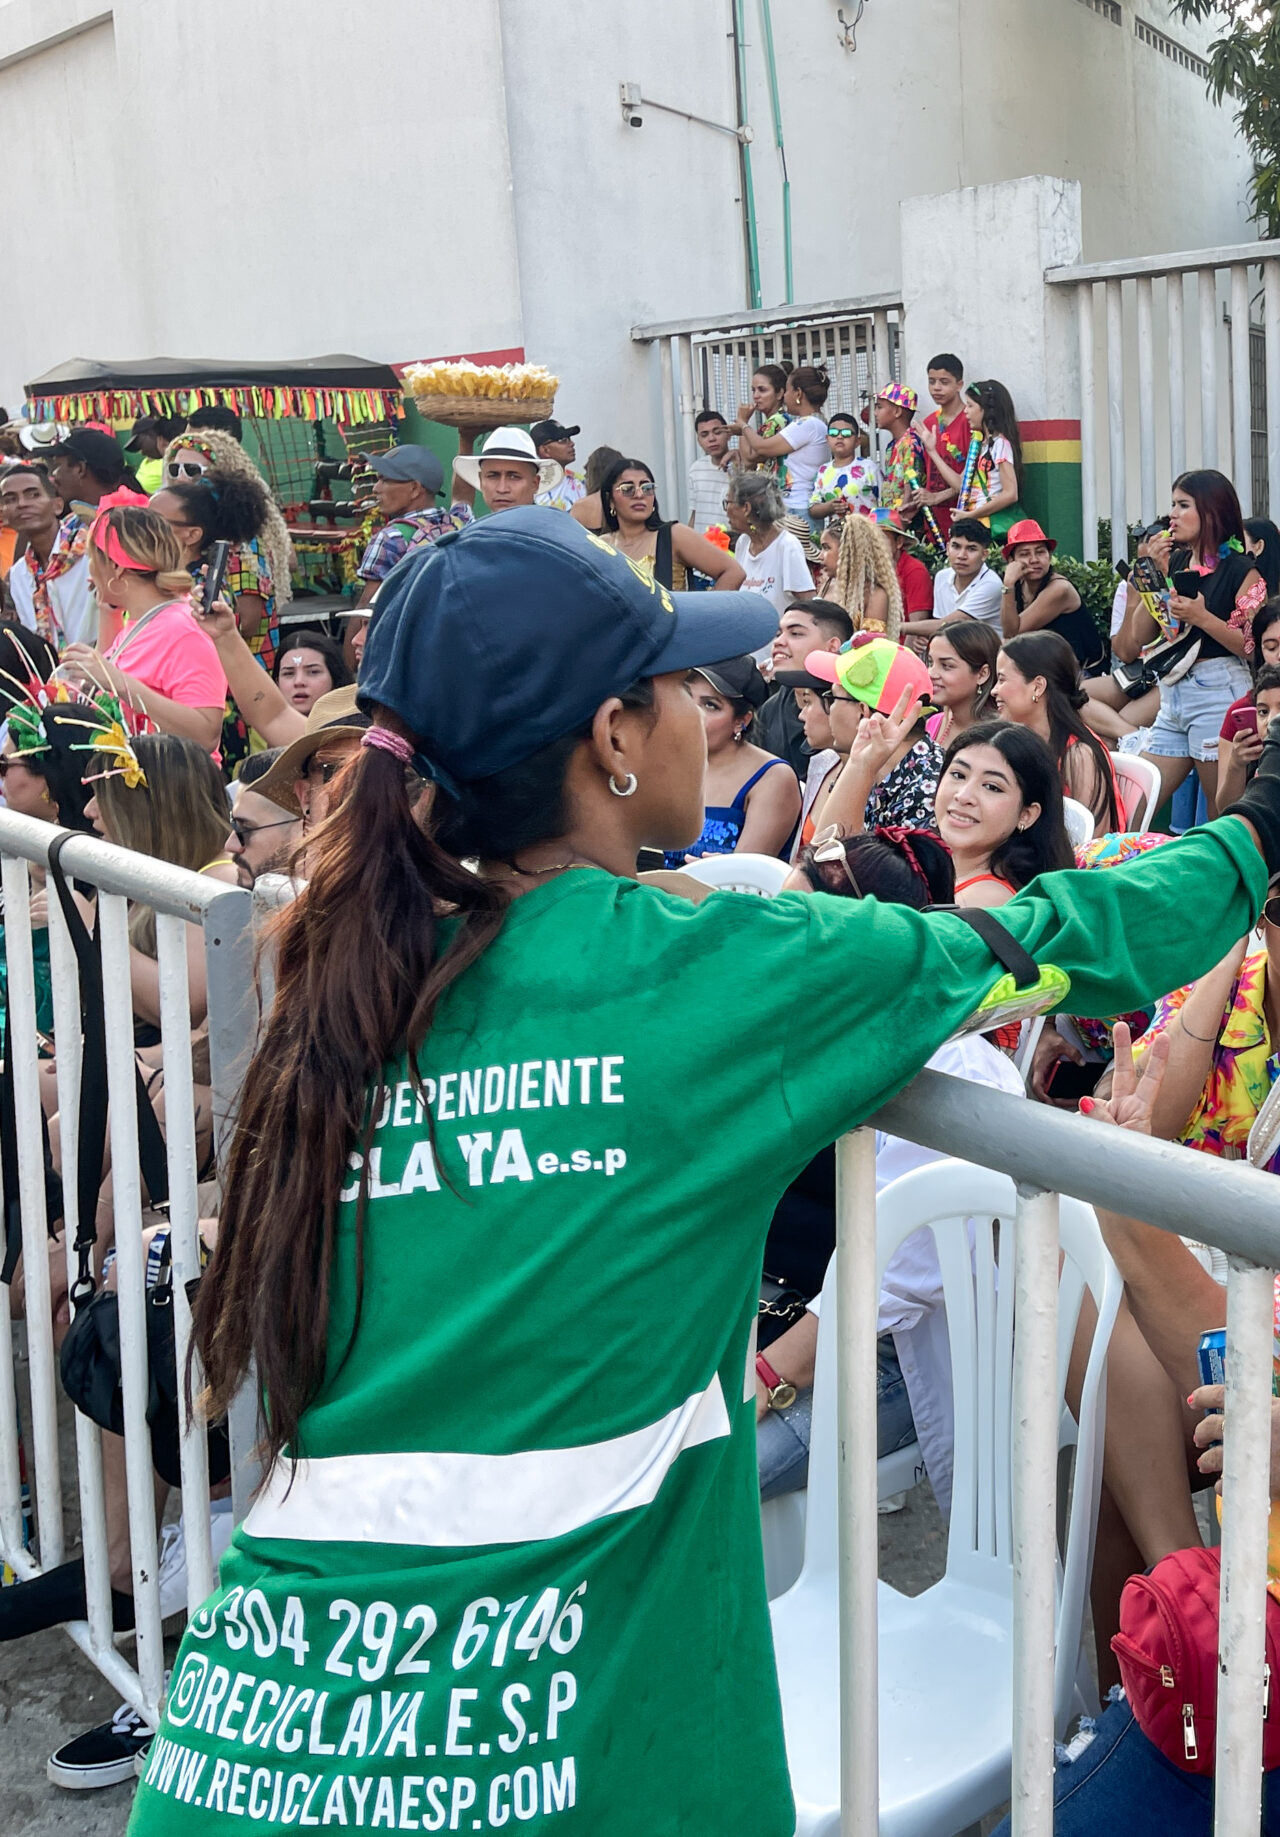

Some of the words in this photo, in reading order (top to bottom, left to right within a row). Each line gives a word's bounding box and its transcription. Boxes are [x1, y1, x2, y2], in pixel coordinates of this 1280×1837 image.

[364, 1055, 624, 1129] DEPENDIENTE
[222, 1585, 311, 1666] 304
[325, 1599, 438, 1682] 292
[452, 1579, 588, 1670] 6146
[144, 1734, 576, 1831] WWW.RECICLAYAESP.COM
